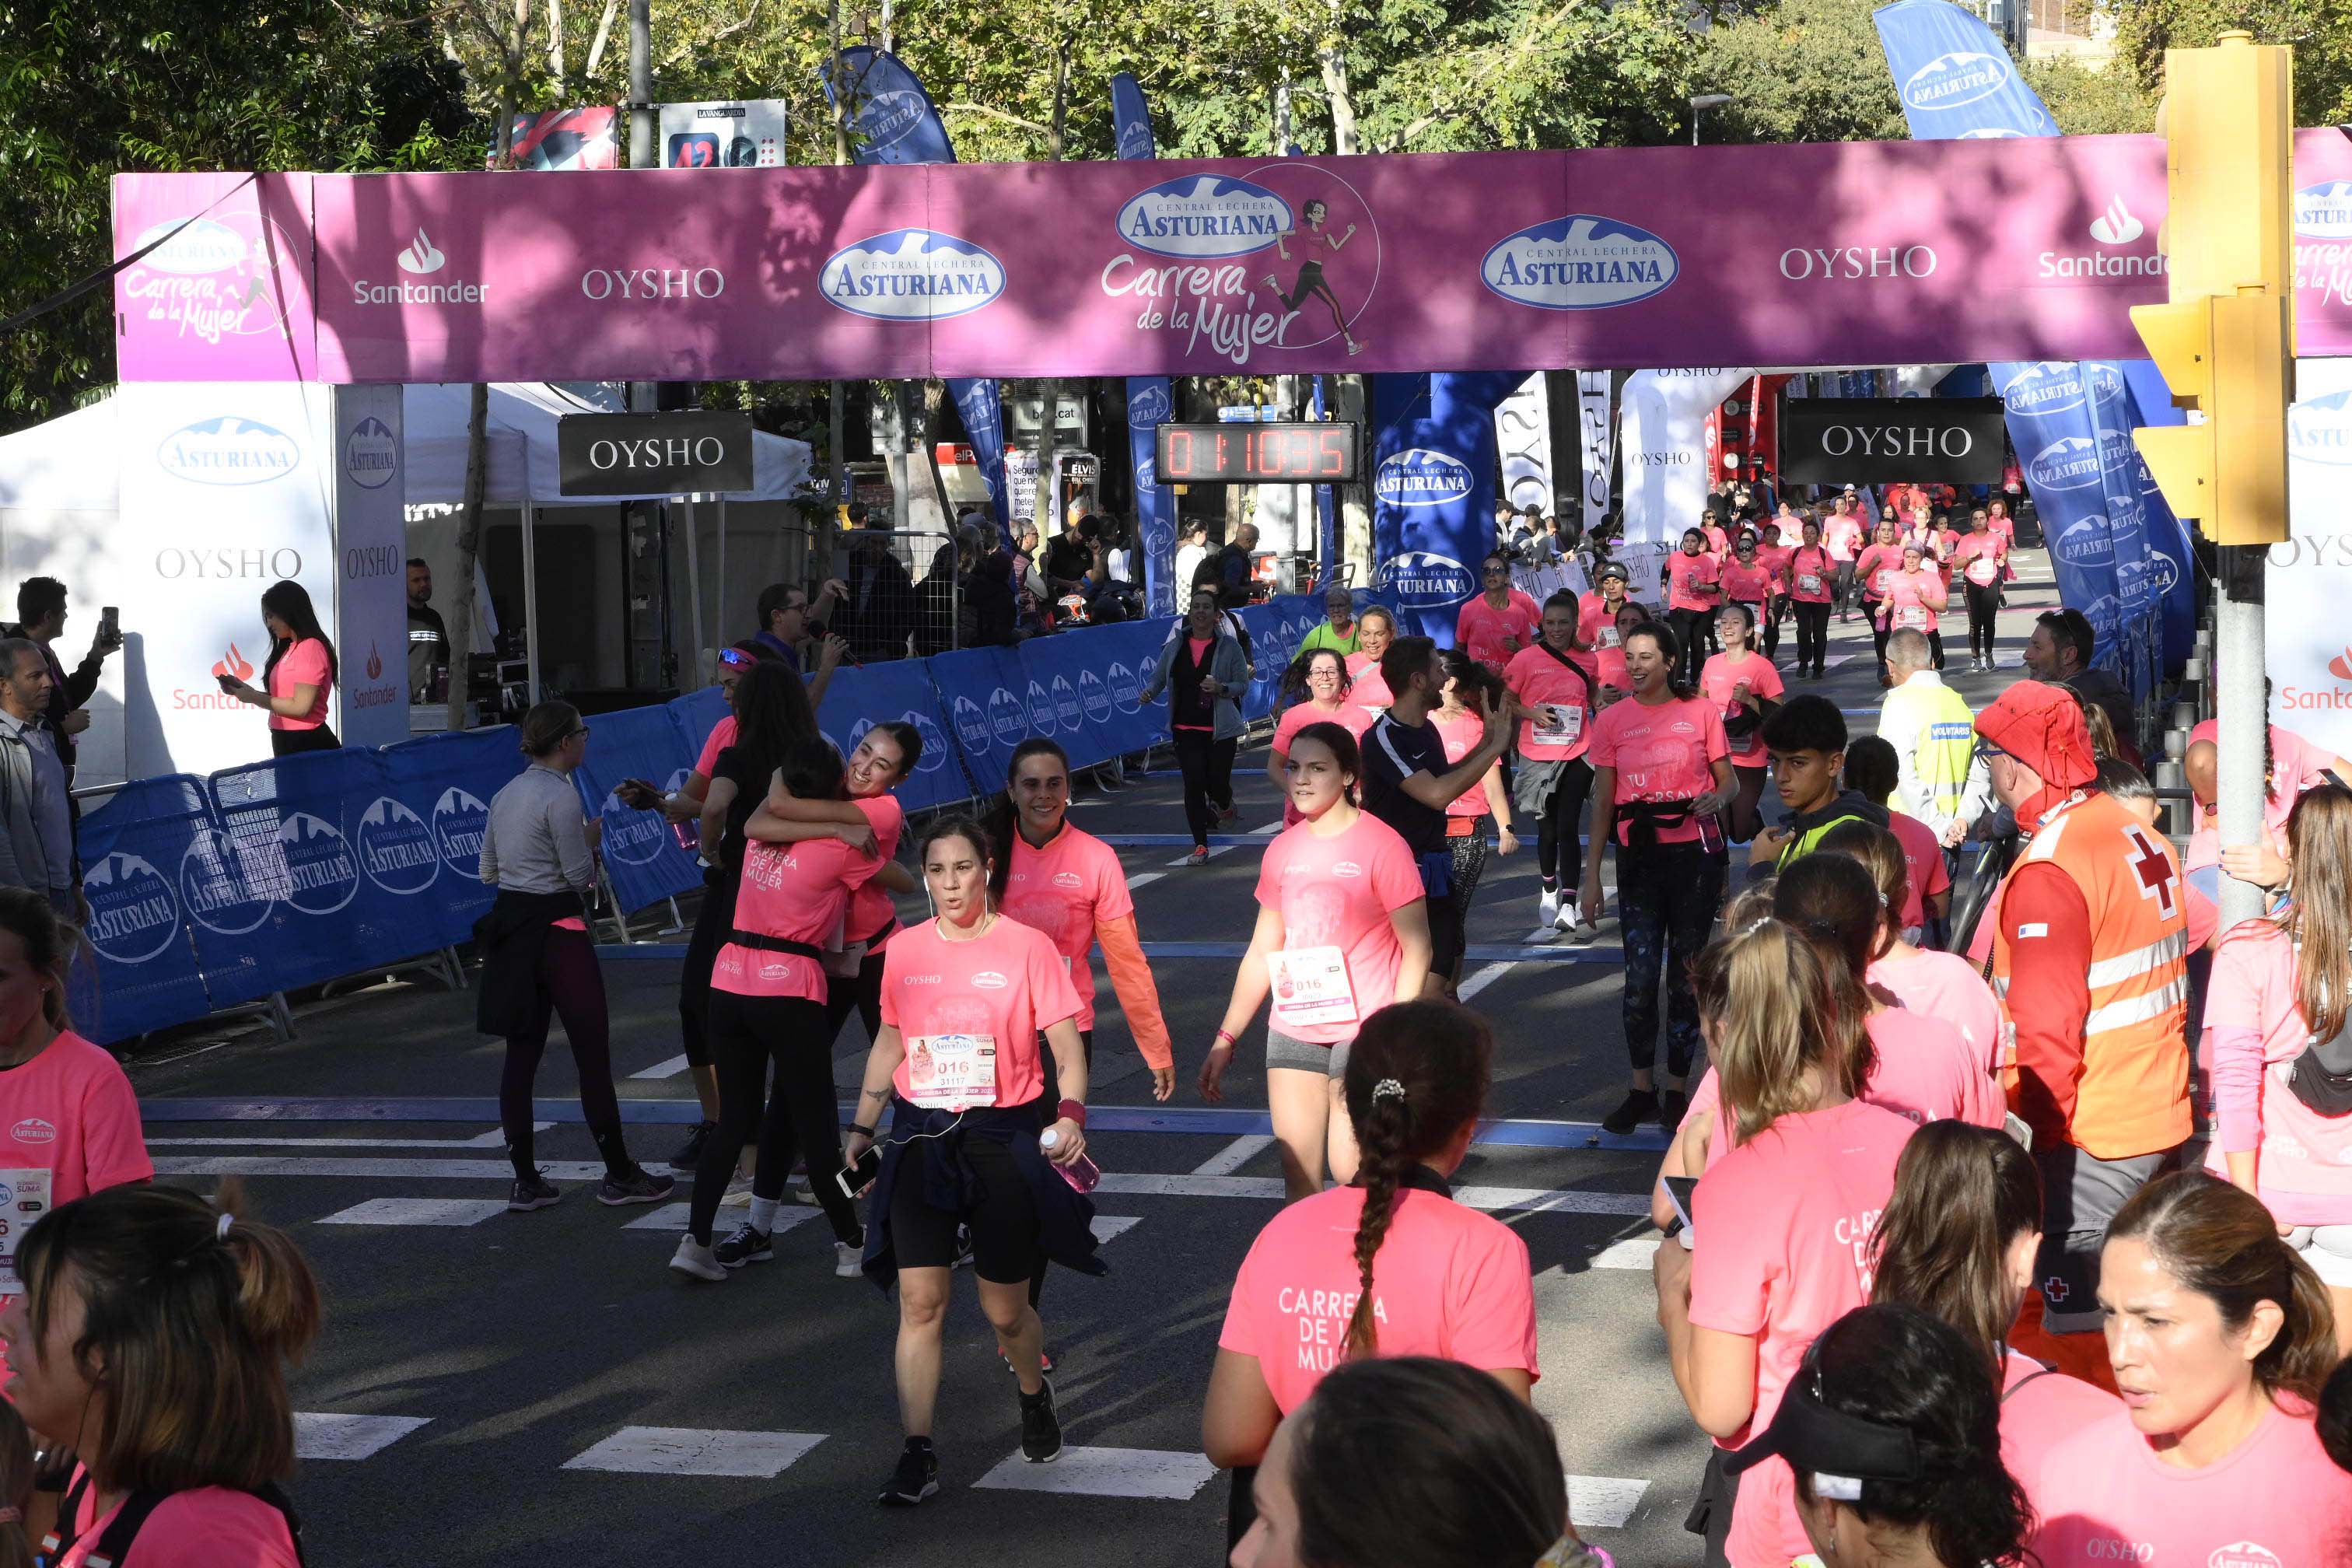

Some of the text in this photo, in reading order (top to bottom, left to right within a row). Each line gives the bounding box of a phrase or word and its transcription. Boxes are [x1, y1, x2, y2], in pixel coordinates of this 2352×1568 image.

[1157, 201, 1275, 212] CENTRAL LECHERA
[1129, 205, 1279, 237] ASTURIANA
[861, 259, 985, 271] CENTRAL LECHERA
[1526, 246, 1657, 258] CENTRAL LECHERA
[1779, 245, 1937, 281] OYSHO
[832, 264, 992, 297] ASTURIANA
[1101, 254, 1246, 298] Carrera
[1496, 250, 1664, 286] ASTURIANA
[124, 269, 217, 299] Carrera
[354, 279, 489, 305] Santander
[582, 267, 725, 300] OYSHO
[148, 296, 252, 345] de la Mujer
[1136, 293, 1301, 366] de la Mujer
[590, 436, 724, 470] OYSHO
[1822, 425, 1972, 457] OYSHO
[170, 442, 290, 467] ASTURIANA
[348, 443, 394, 471] ASTURIANA
[1632, 451, 1691, 467] OYSHO
[1013, 476, 1027, 488] que
[1378, 471, 1467, 493] ASTURIANA
[1015, 508, 1030, 516] este
[155, 548, 302, 579] OYSHO
[346, 544, 399, 579] OYSHO
[353, 685, 397, 709] Santander
[1626, 773, 1646, 789] TU
[366, 836, 436, 874] ASTURIANA
[747, 842, 797, 871] CARRERA
[751, 856, 782, 876] DE LA
[745, 867, 782, 890] MUJER
[904, 975, 941, 985] OYSHO
[935, 1041, 971, 1051] ASTURIANA
[938, 1061, 969, 1075] 016
[940, 1077, 965, 1086] 31117
[14, 1127, 54, 1139] ASTURIANA
[1299, 1316, 1328, 1345] DE
[2087, 1537, 2154, 1563] OYSHO
